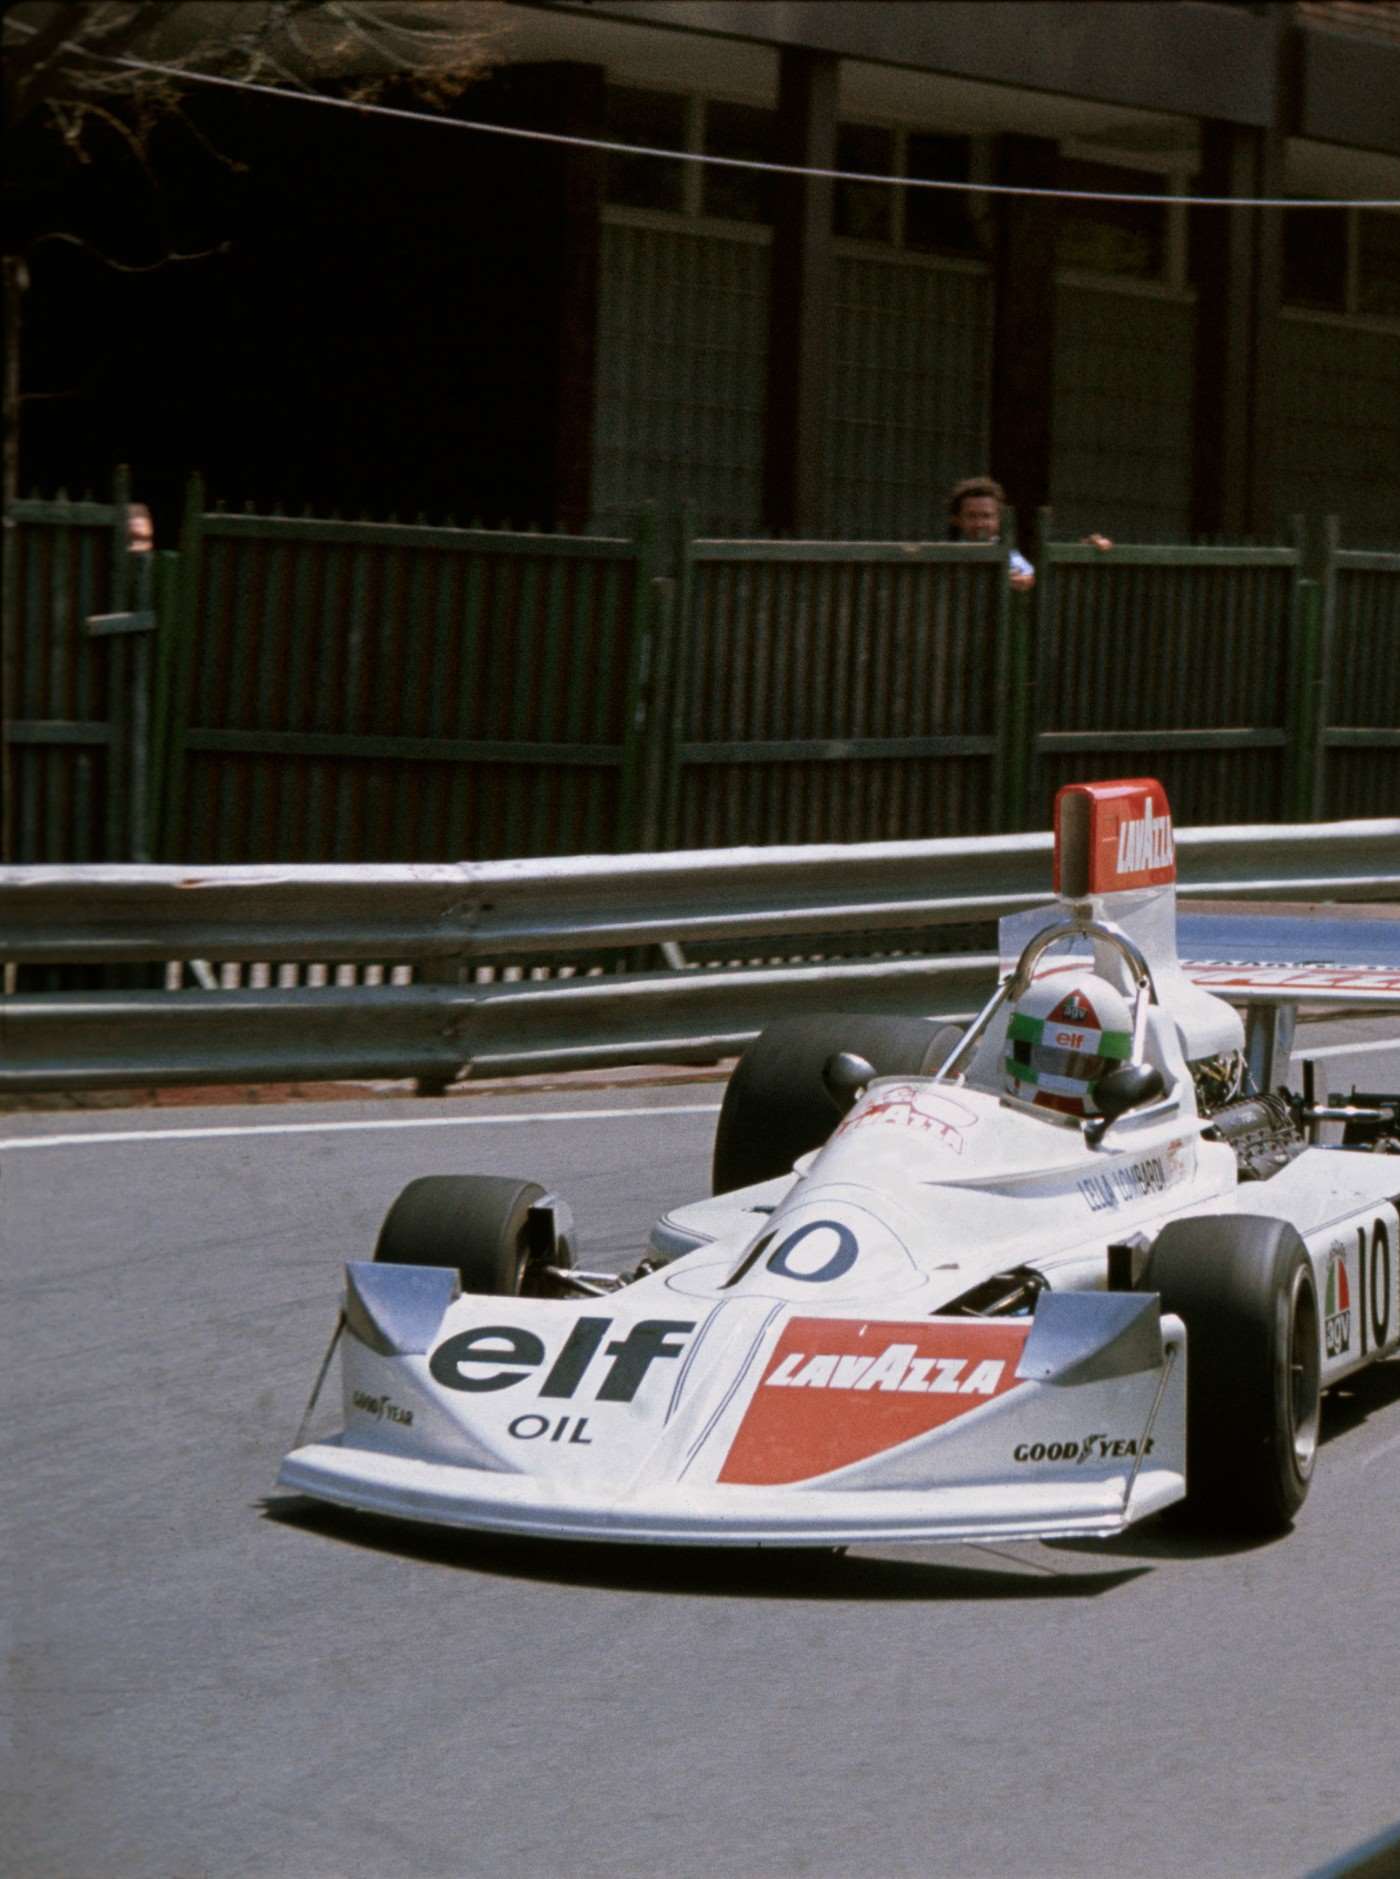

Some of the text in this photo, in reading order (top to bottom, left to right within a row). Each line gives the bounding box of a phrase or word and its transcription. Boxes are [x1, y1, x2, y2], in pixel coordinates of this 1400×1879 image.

[1055, 1033, 1085, 1049] elf
[1357, 1217, 1390, 1358] 10
[1326, 1313, 1350, 1355] agv
[429, 1316, 697, 1403] elf
[766, 1344, 1005, 1395] LAVAZZA
[508, 1414, 592, 1445] OIL
